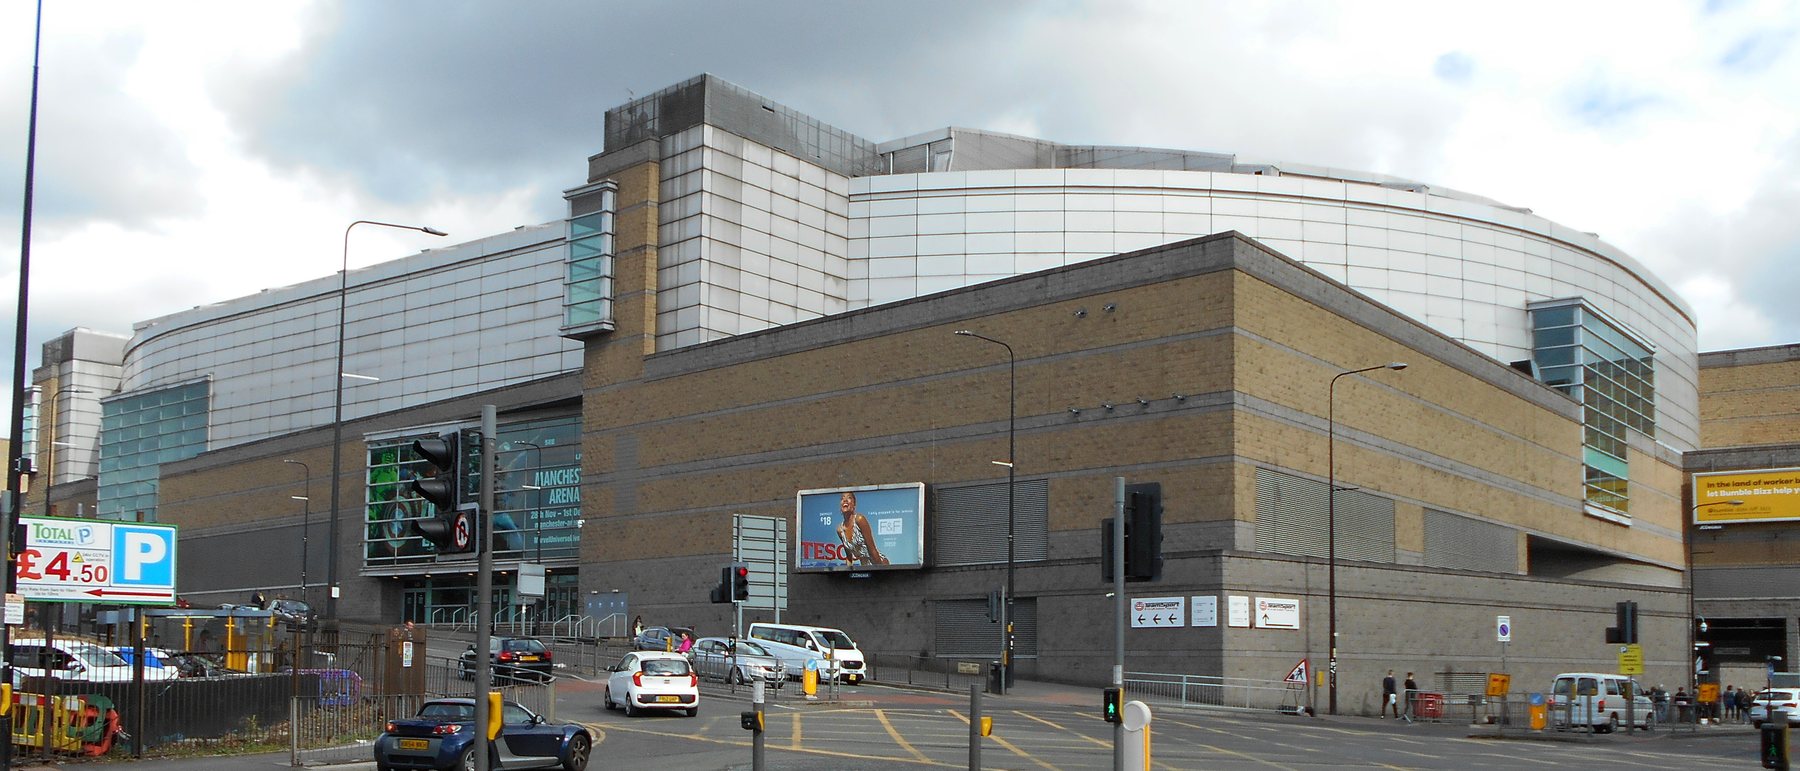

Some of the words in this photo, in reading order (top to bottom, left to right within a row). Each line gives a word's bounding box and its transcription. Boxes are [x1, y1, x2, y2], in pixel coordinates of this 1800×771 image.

[534, 467, 582, 488] MANCHES
[1763, 478, 1793, 486] worker
[548, 486, 580, 505] ARENA
[1773, 487, 1793, 495] help
[124, 532, 167, 581] P
